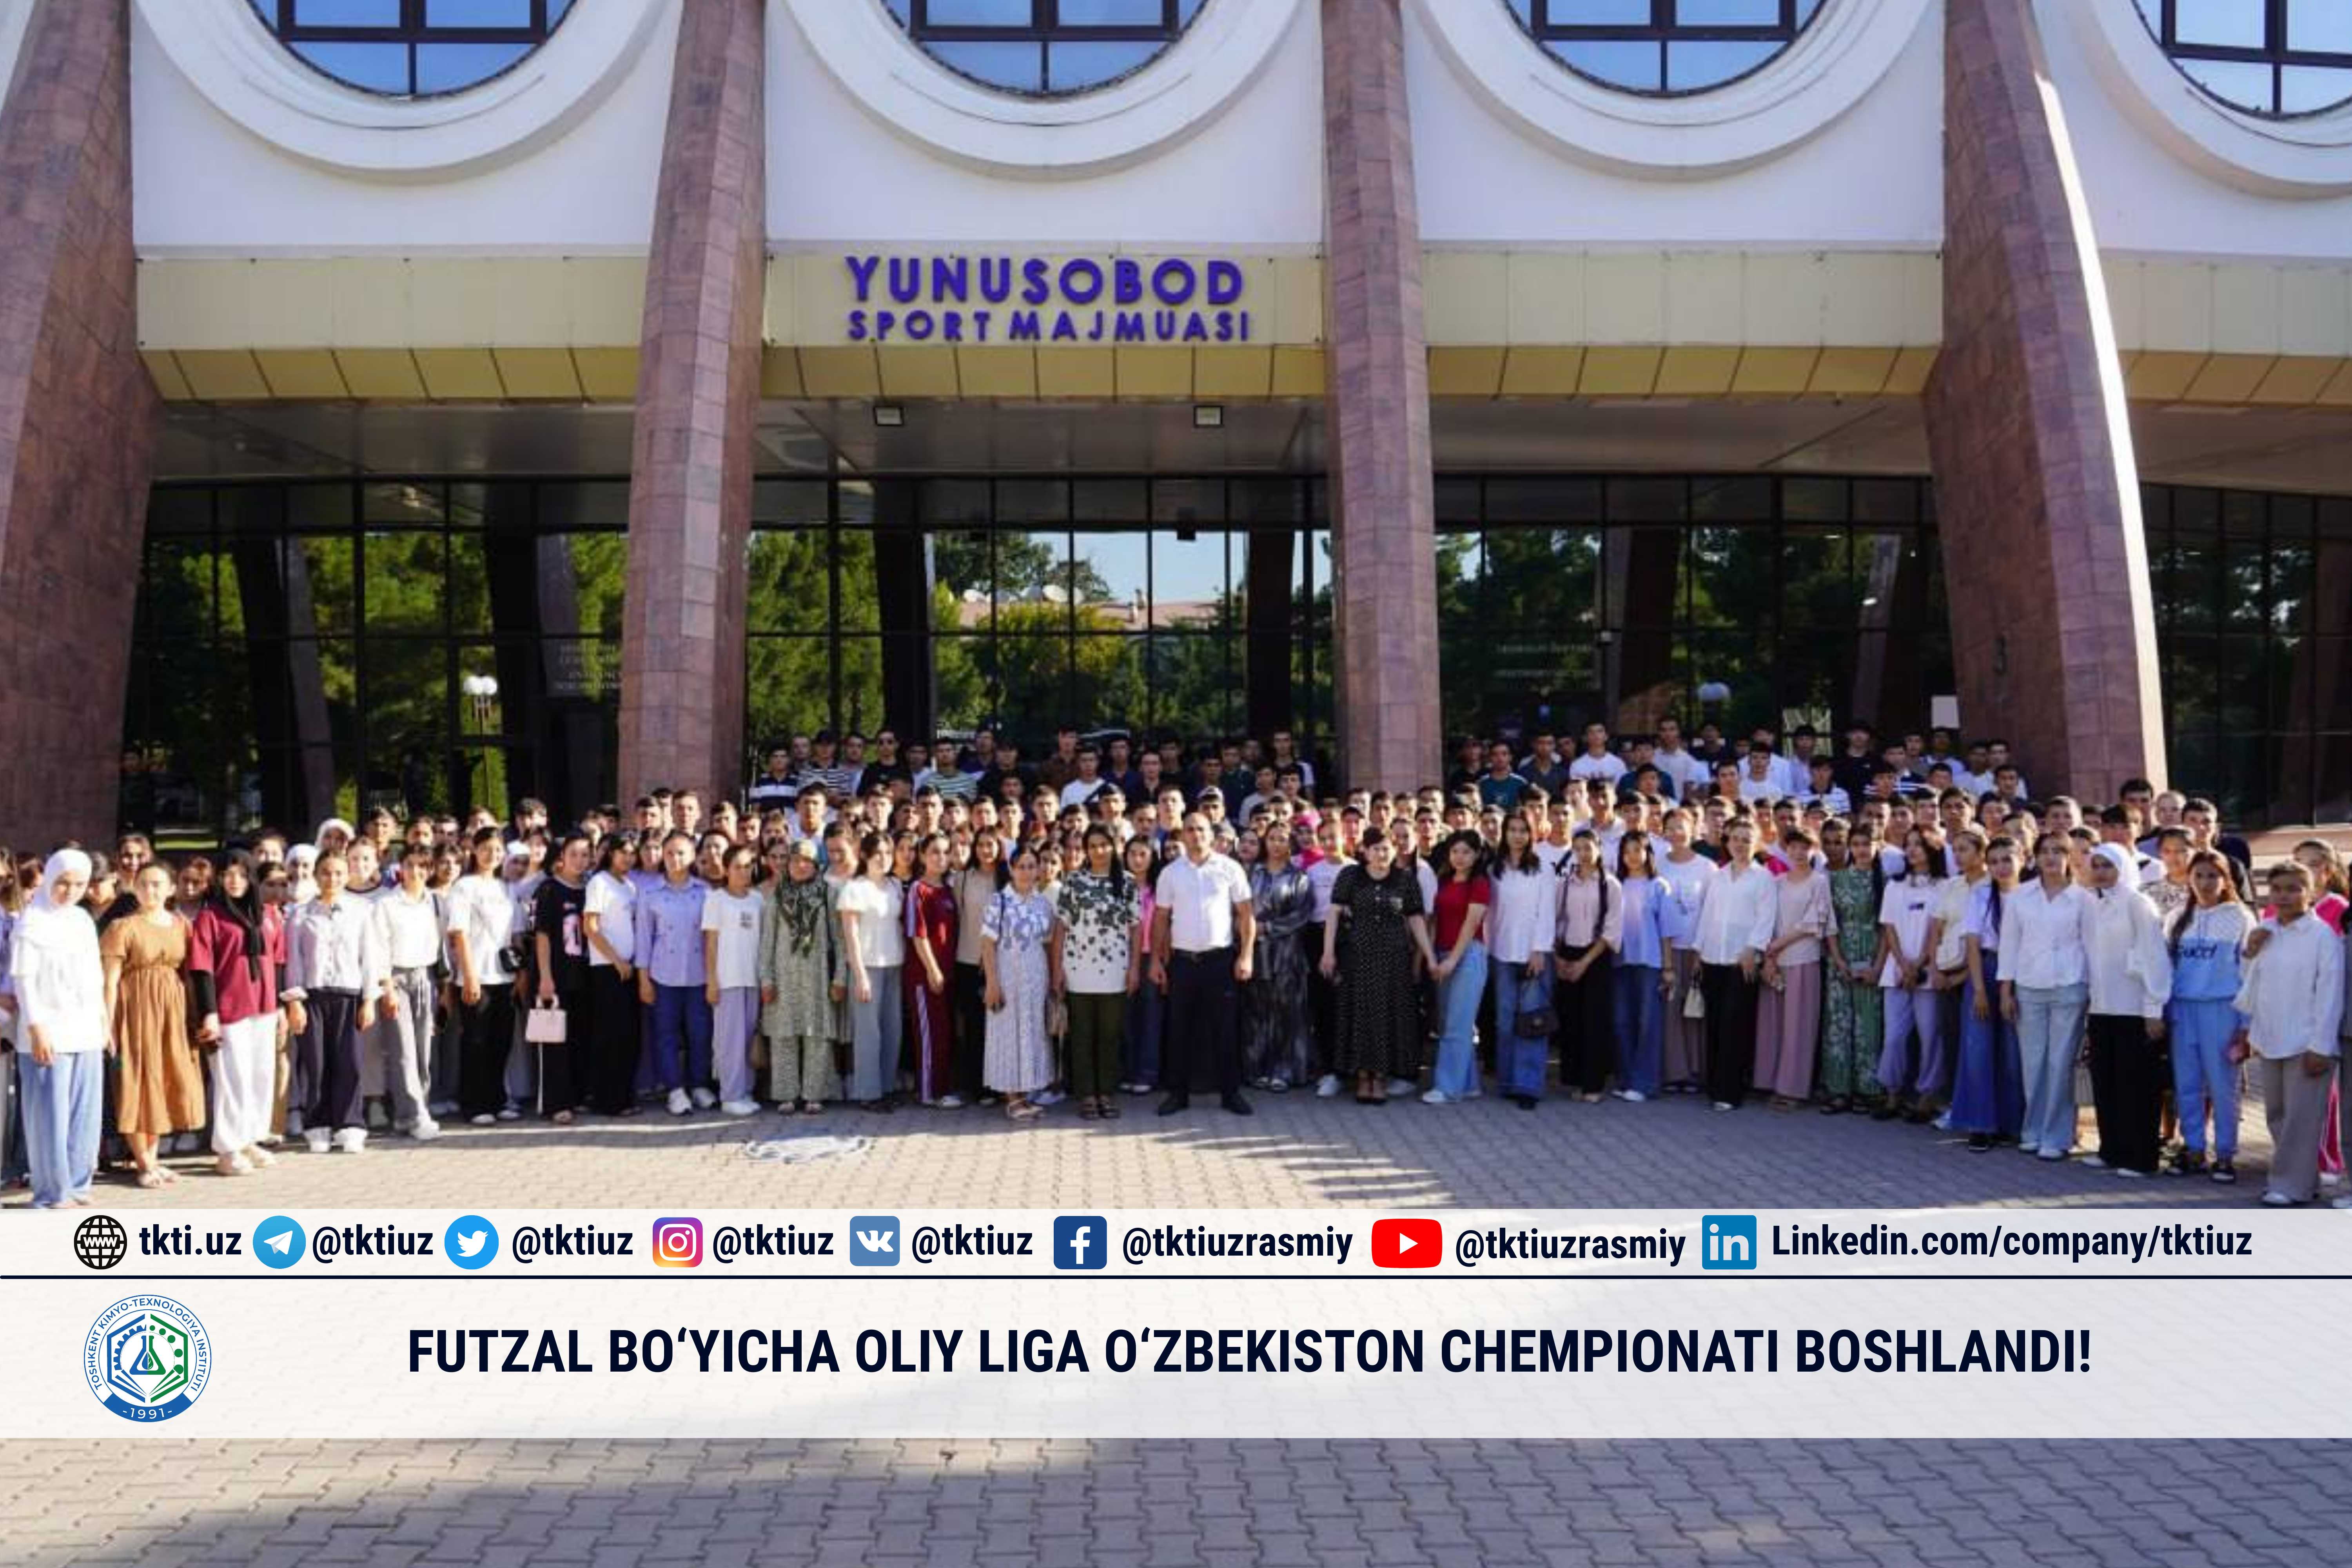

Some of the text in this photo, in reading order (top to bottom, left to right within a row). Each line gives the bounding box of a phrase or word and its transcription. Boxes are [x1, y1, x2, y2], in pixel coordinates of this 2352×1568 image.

[846, 256, 1243, 305] YUNUSOBOD
[848, 310, 1249, 341] SPORT MAJMUASI
